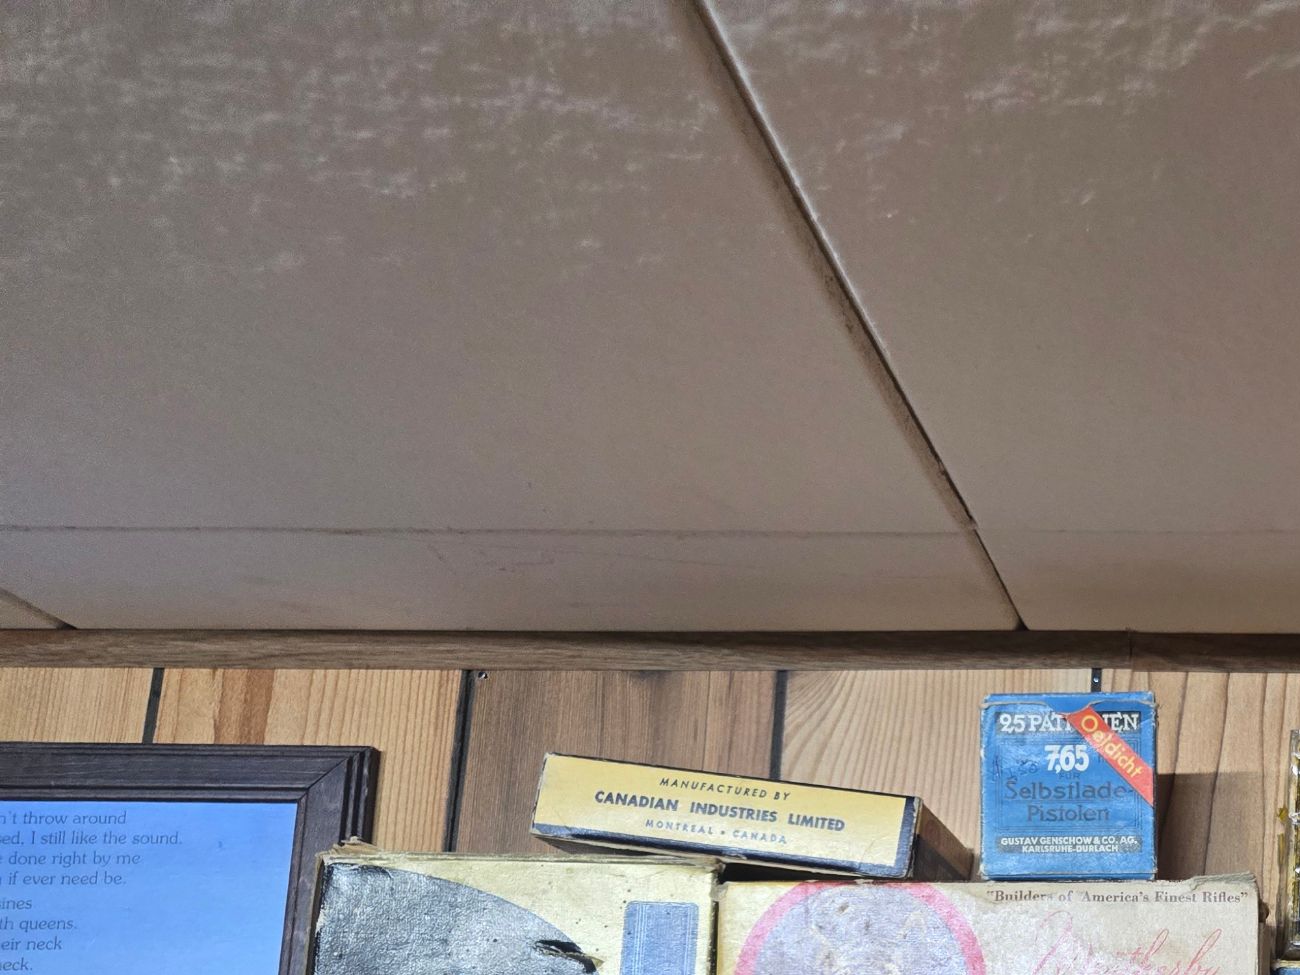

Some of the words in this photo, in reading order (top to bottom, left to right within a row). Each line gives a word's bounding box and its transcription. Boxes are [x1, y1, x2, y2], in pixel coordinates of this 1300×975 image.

[1000, 714, 1025, 732] 25
[1081, 715, 1142, 778] Oeldicht
[660, 778, 767, 798] MANUFACTURED
[775, 791, 790, 800] BY
[1005, 781, 1133, 800] Selbstlade-
[23, 811, 67, 824] throw
[73, 811, 127, 824] around
[595, 791, 678, 811] CANADIAN
[690, 802, 777, 822] INDUSTRIES
[788, 813, 845, 832] LIMITED
[1027, 805, 1110, 822] Pistolen
[41, 831, 65, 844] still
[72, 831, 97, 844] like
[103, 831, 127, 844] the
[132, 831, 182, 844] sound.
[646, 820, 713, 835] MONTREAL
[733, 830, 787, 844] CANADA
[1001, 837, 1038, 845] GUSTAV
[9, 852, 46, 865] done
[52, 851, 87, 868] right
[93, 851, 111, 868] by
[116, 855, 141, 864] me
[1155, 891, 1196, 902] Finest
